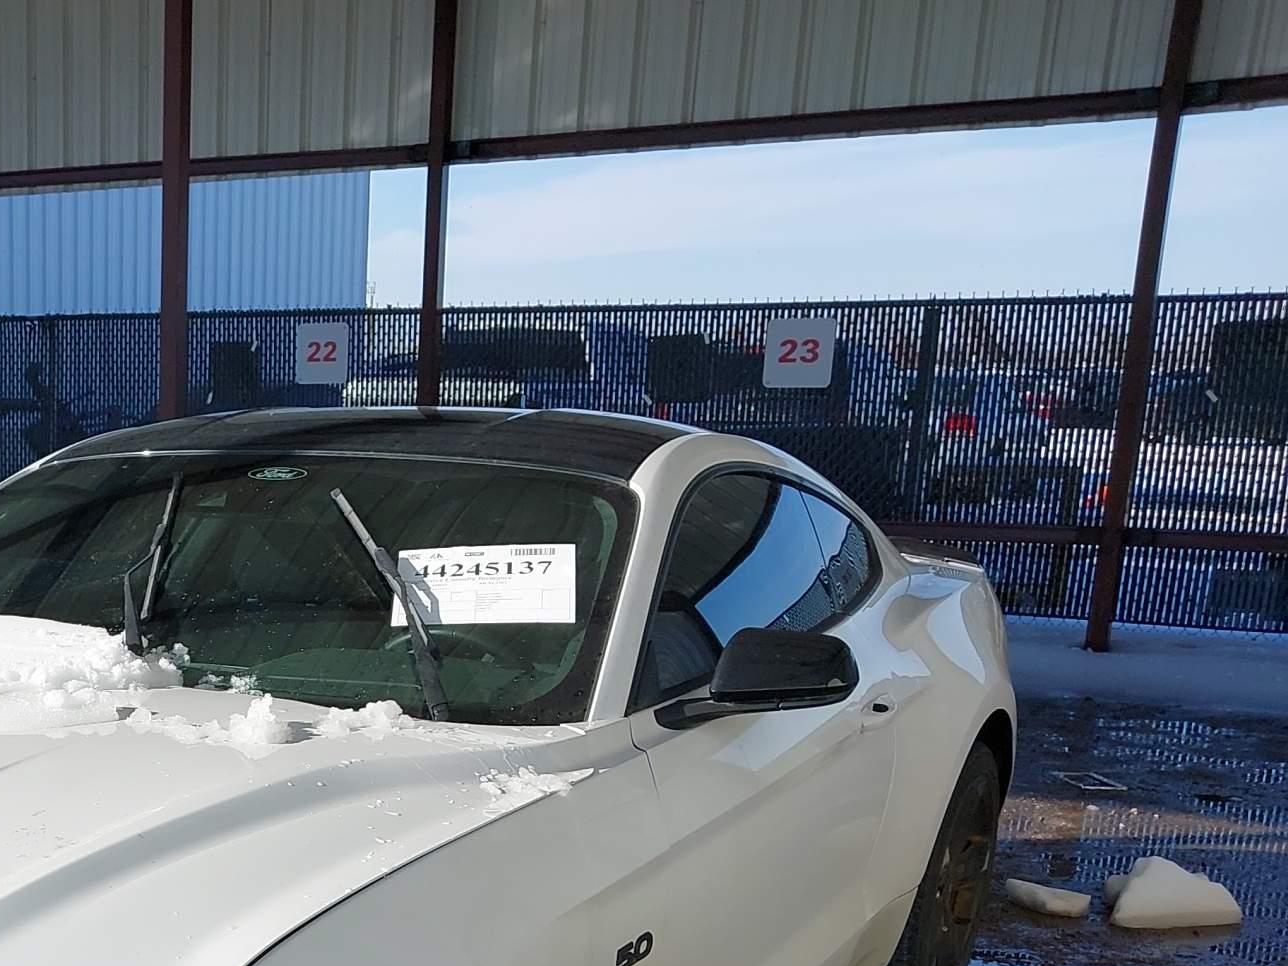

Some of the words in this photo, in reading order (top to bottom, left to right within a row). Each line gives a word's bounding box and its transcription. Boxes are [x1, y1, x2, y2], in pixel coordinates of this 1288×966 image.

[307, 341, 337, 362] 22
[778, 339, 820, 363] 23
[253, 468, 300, 479] Ford
[414, 560, 553, 578] 44245137
